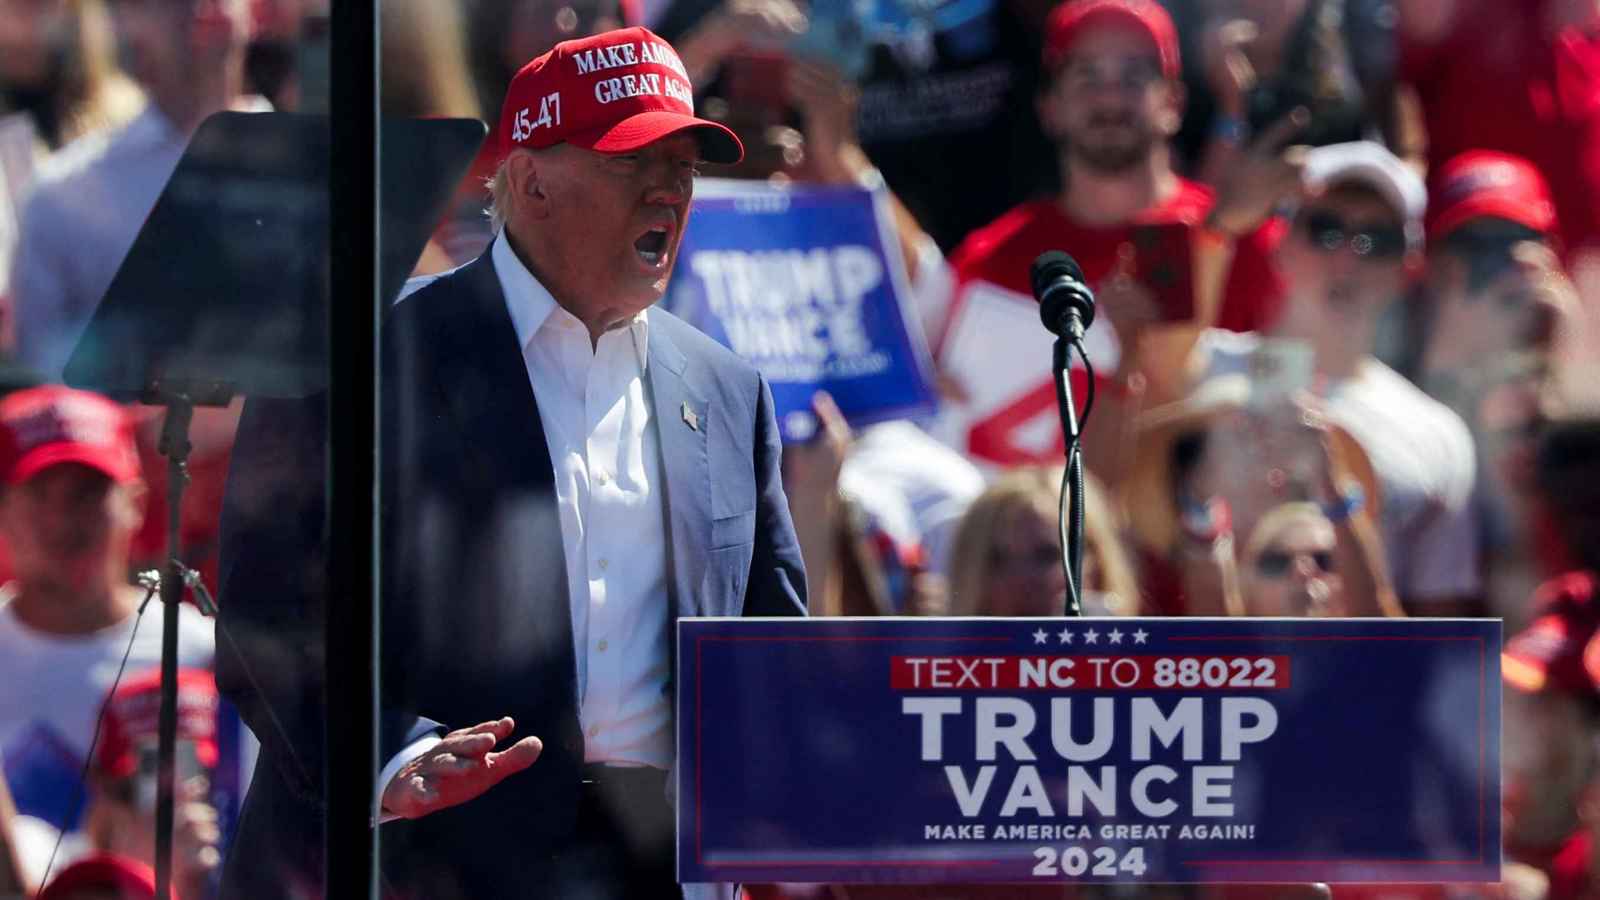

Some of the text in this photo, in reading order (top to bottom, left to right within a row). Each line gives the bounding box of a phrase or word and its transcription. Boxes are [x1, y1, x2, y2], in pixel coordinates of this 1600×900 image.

[573, 43, 638, 75] MAKE
[594, 73, 660, 104] GREAT
[511, 91, 561, 142] 45-47
[691, 245, 883, 313] TRUMP
[905, 657, 1277, 688] TEXT NC TO 88022
[902, 697, 1279, 762] TRUMP
[944, 765, 1236, 818] VANCE
[925, 824, 1256, 840] MAKE AMERICA GREAT AGAIN!
[1032, 846, 1148, 876] 2024
